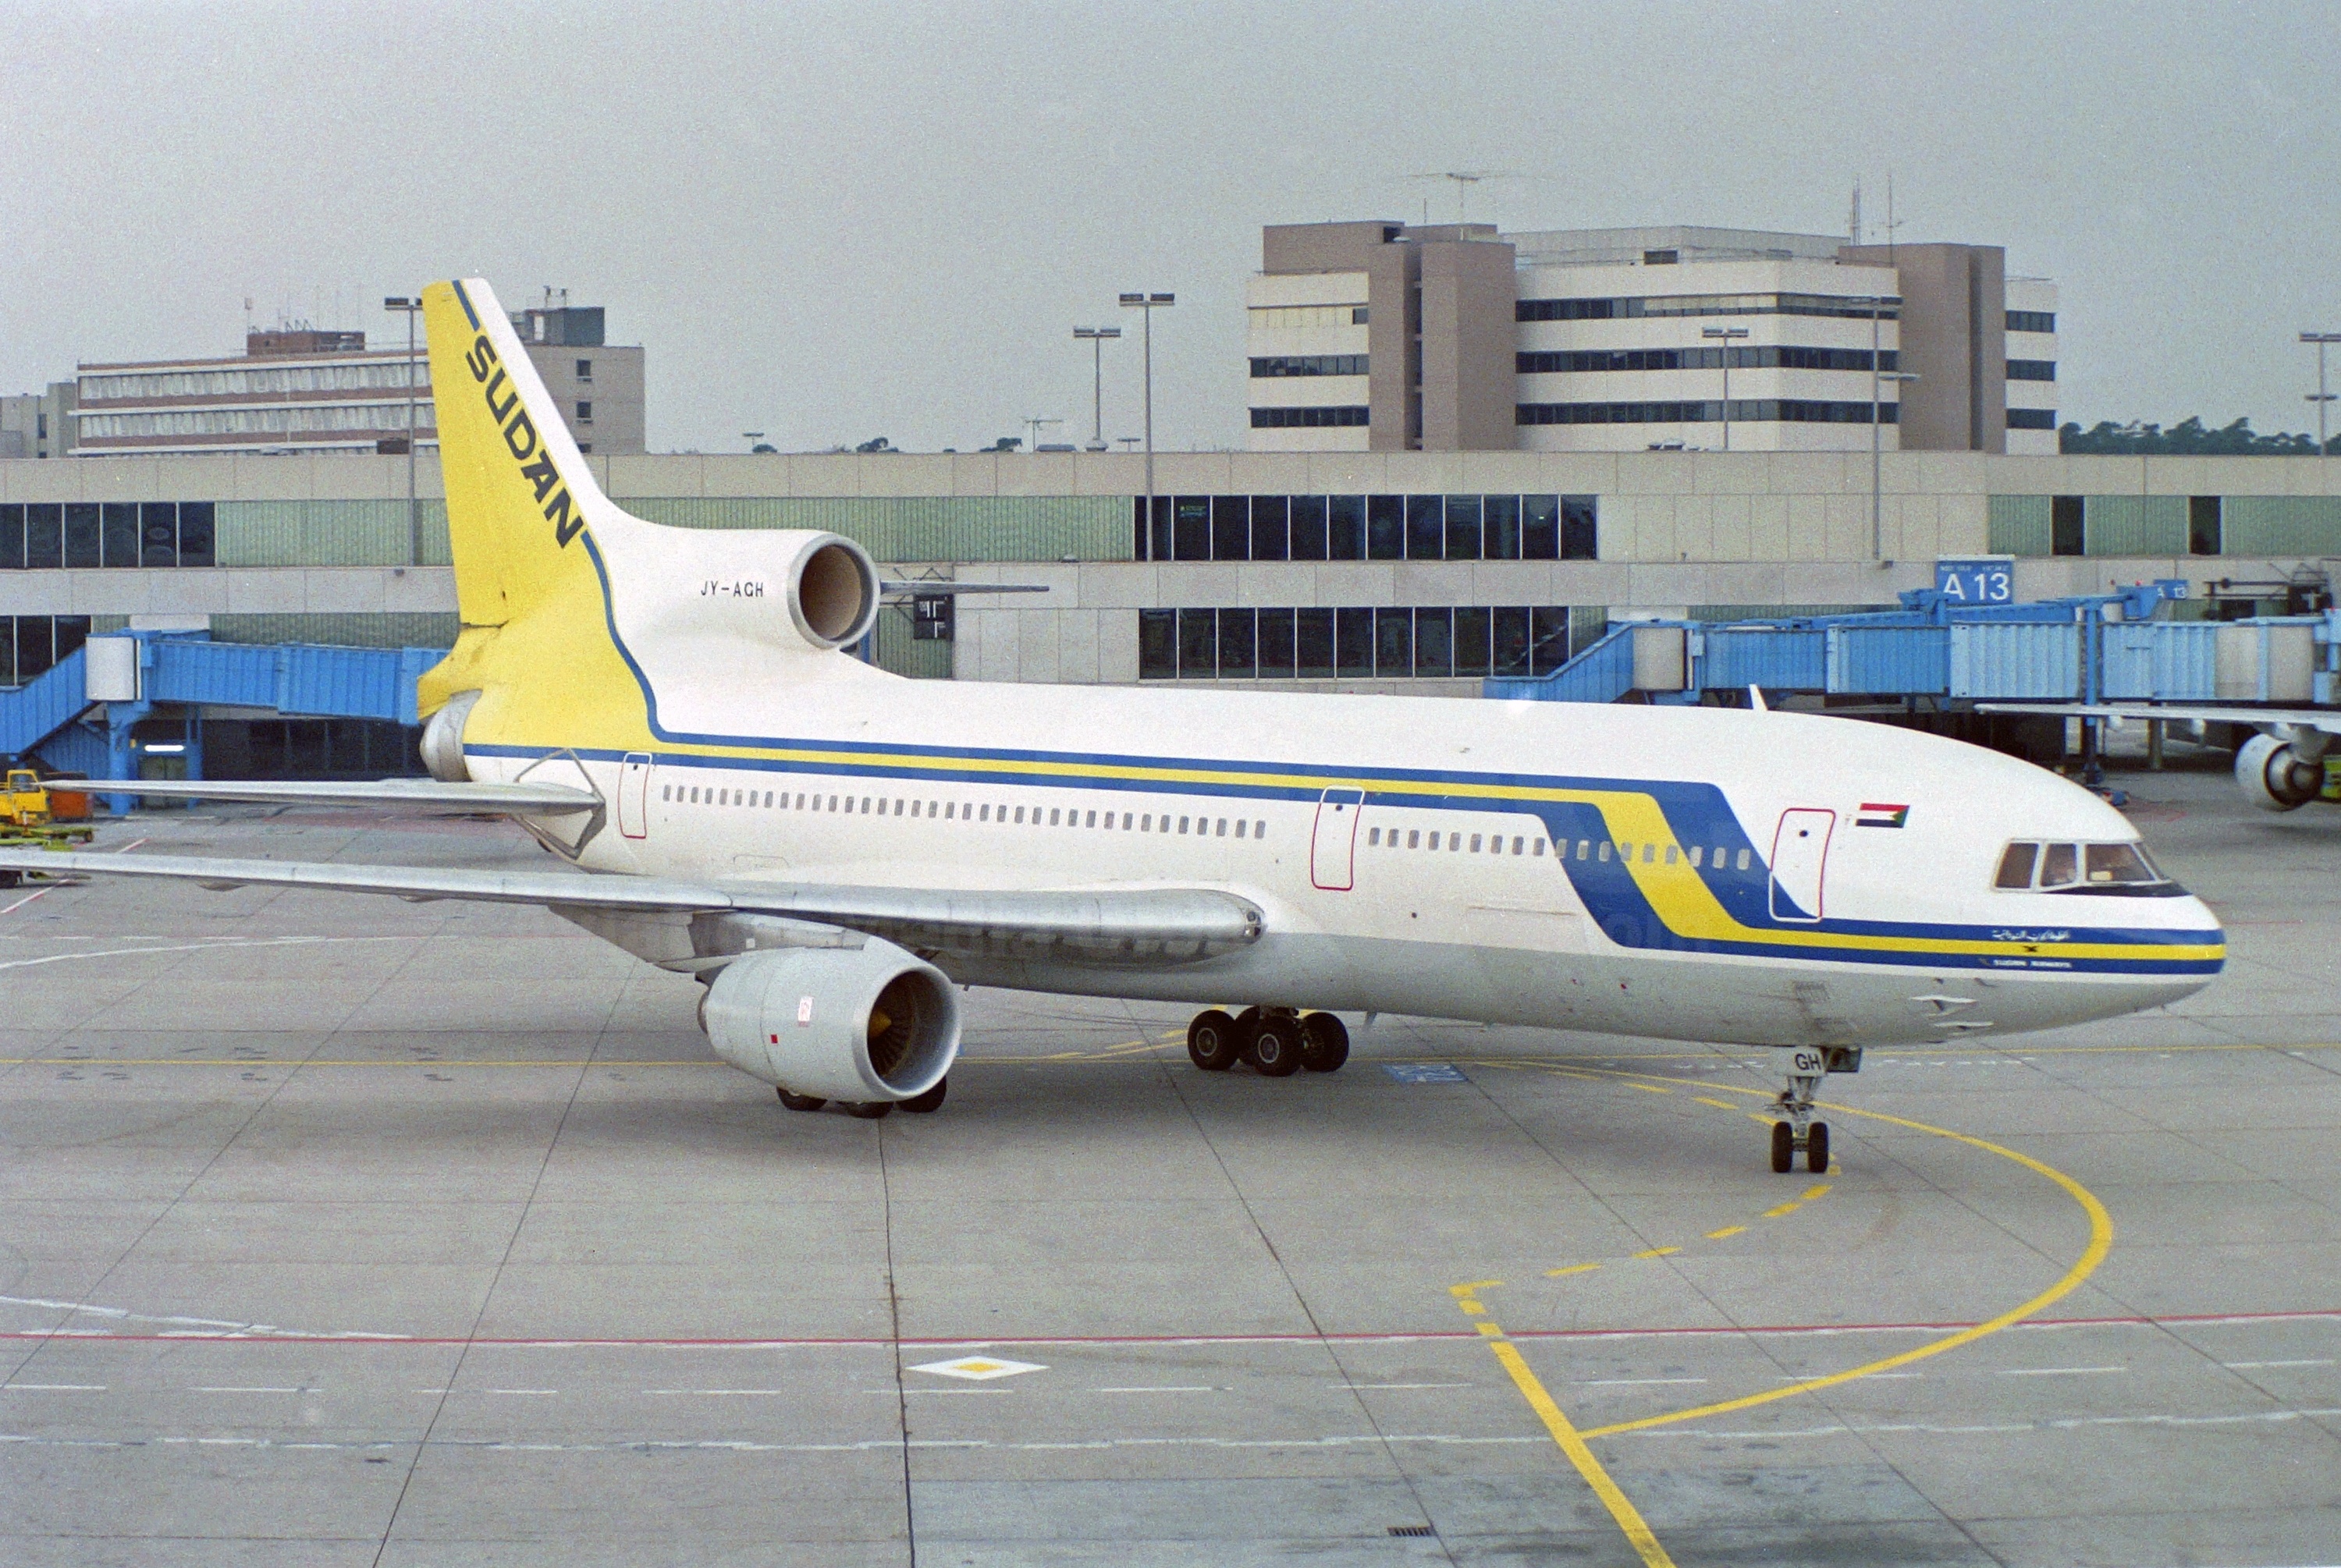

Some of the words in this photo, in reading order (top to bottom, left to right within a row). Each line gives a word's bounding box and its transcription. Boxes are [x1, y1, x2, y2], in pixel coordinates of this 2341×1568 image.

[466, 335, 584, 549] SUDAN
[701, 580, 764, 598] JY-AGH
[1943, 573, 1966, 600] A
[1974, 573, 2009, 601] 13
[1795, 1053, 1821, 1070] GH
